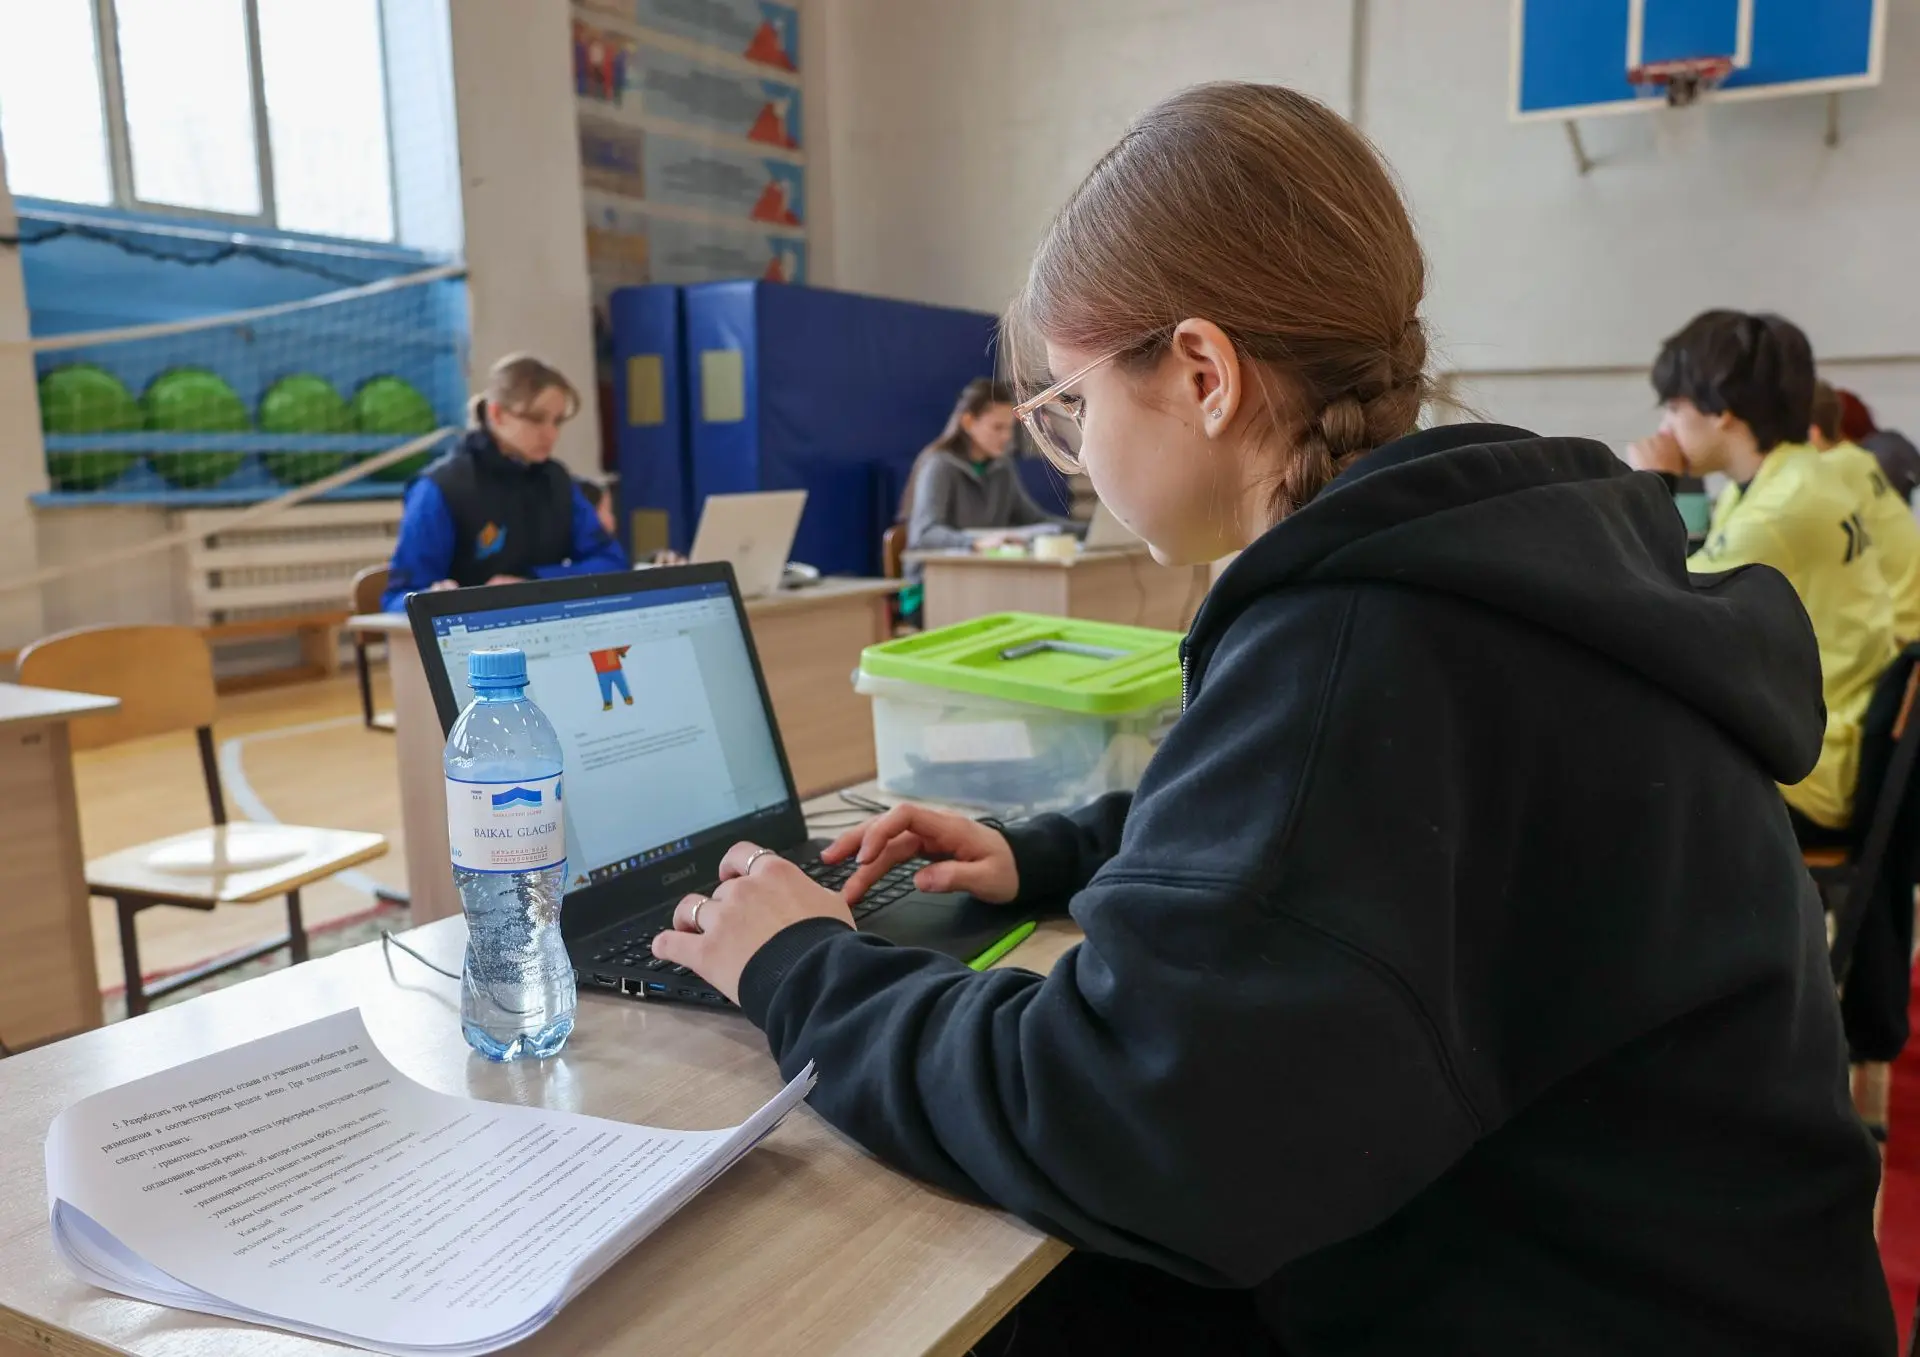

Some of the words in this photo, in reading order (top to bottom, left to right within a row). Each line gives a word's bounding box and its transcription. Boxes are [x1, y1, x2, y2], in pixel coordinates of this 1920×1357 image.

[474, 828, 513, 838] BAIKAL
[517, 822, 557, 837] GLACIER
[101, 1131, 152, 1154] размещения
[165, 1105, 232, 1130] соответствующем
[234, 1095, 262, 1109] разделе
[288, 1080, 304, 1089] При
[122, 1108, 171, 1126] Разработать
[172, 1103, 187, 1112] три
[188, 1087, 235, 1108] развернутых
[236, 1078, 261, 1090] отзыва
[115, 1150, 148, 1165] следует
[148, 1136, 192, 1155] учитывать:
[158, 1148, 207, 1168] грамотность
[207, 1132, 248, 1150] изложения
[249, 1123, 272, 1135] текста
[142, 1169, 196, 1192] согласование
[195, 1158, 223, 1171] частей
[184, 1174, 228, 1195] включение
[228, 1161, 257, 1178] данных
[257, 1156, 267, 1165] об
[267, 1148, 291, 1161] авторе
[198, 1171, 274, 1208] разнохарактерность
[212, 1190, 267, 1218] уникальность
